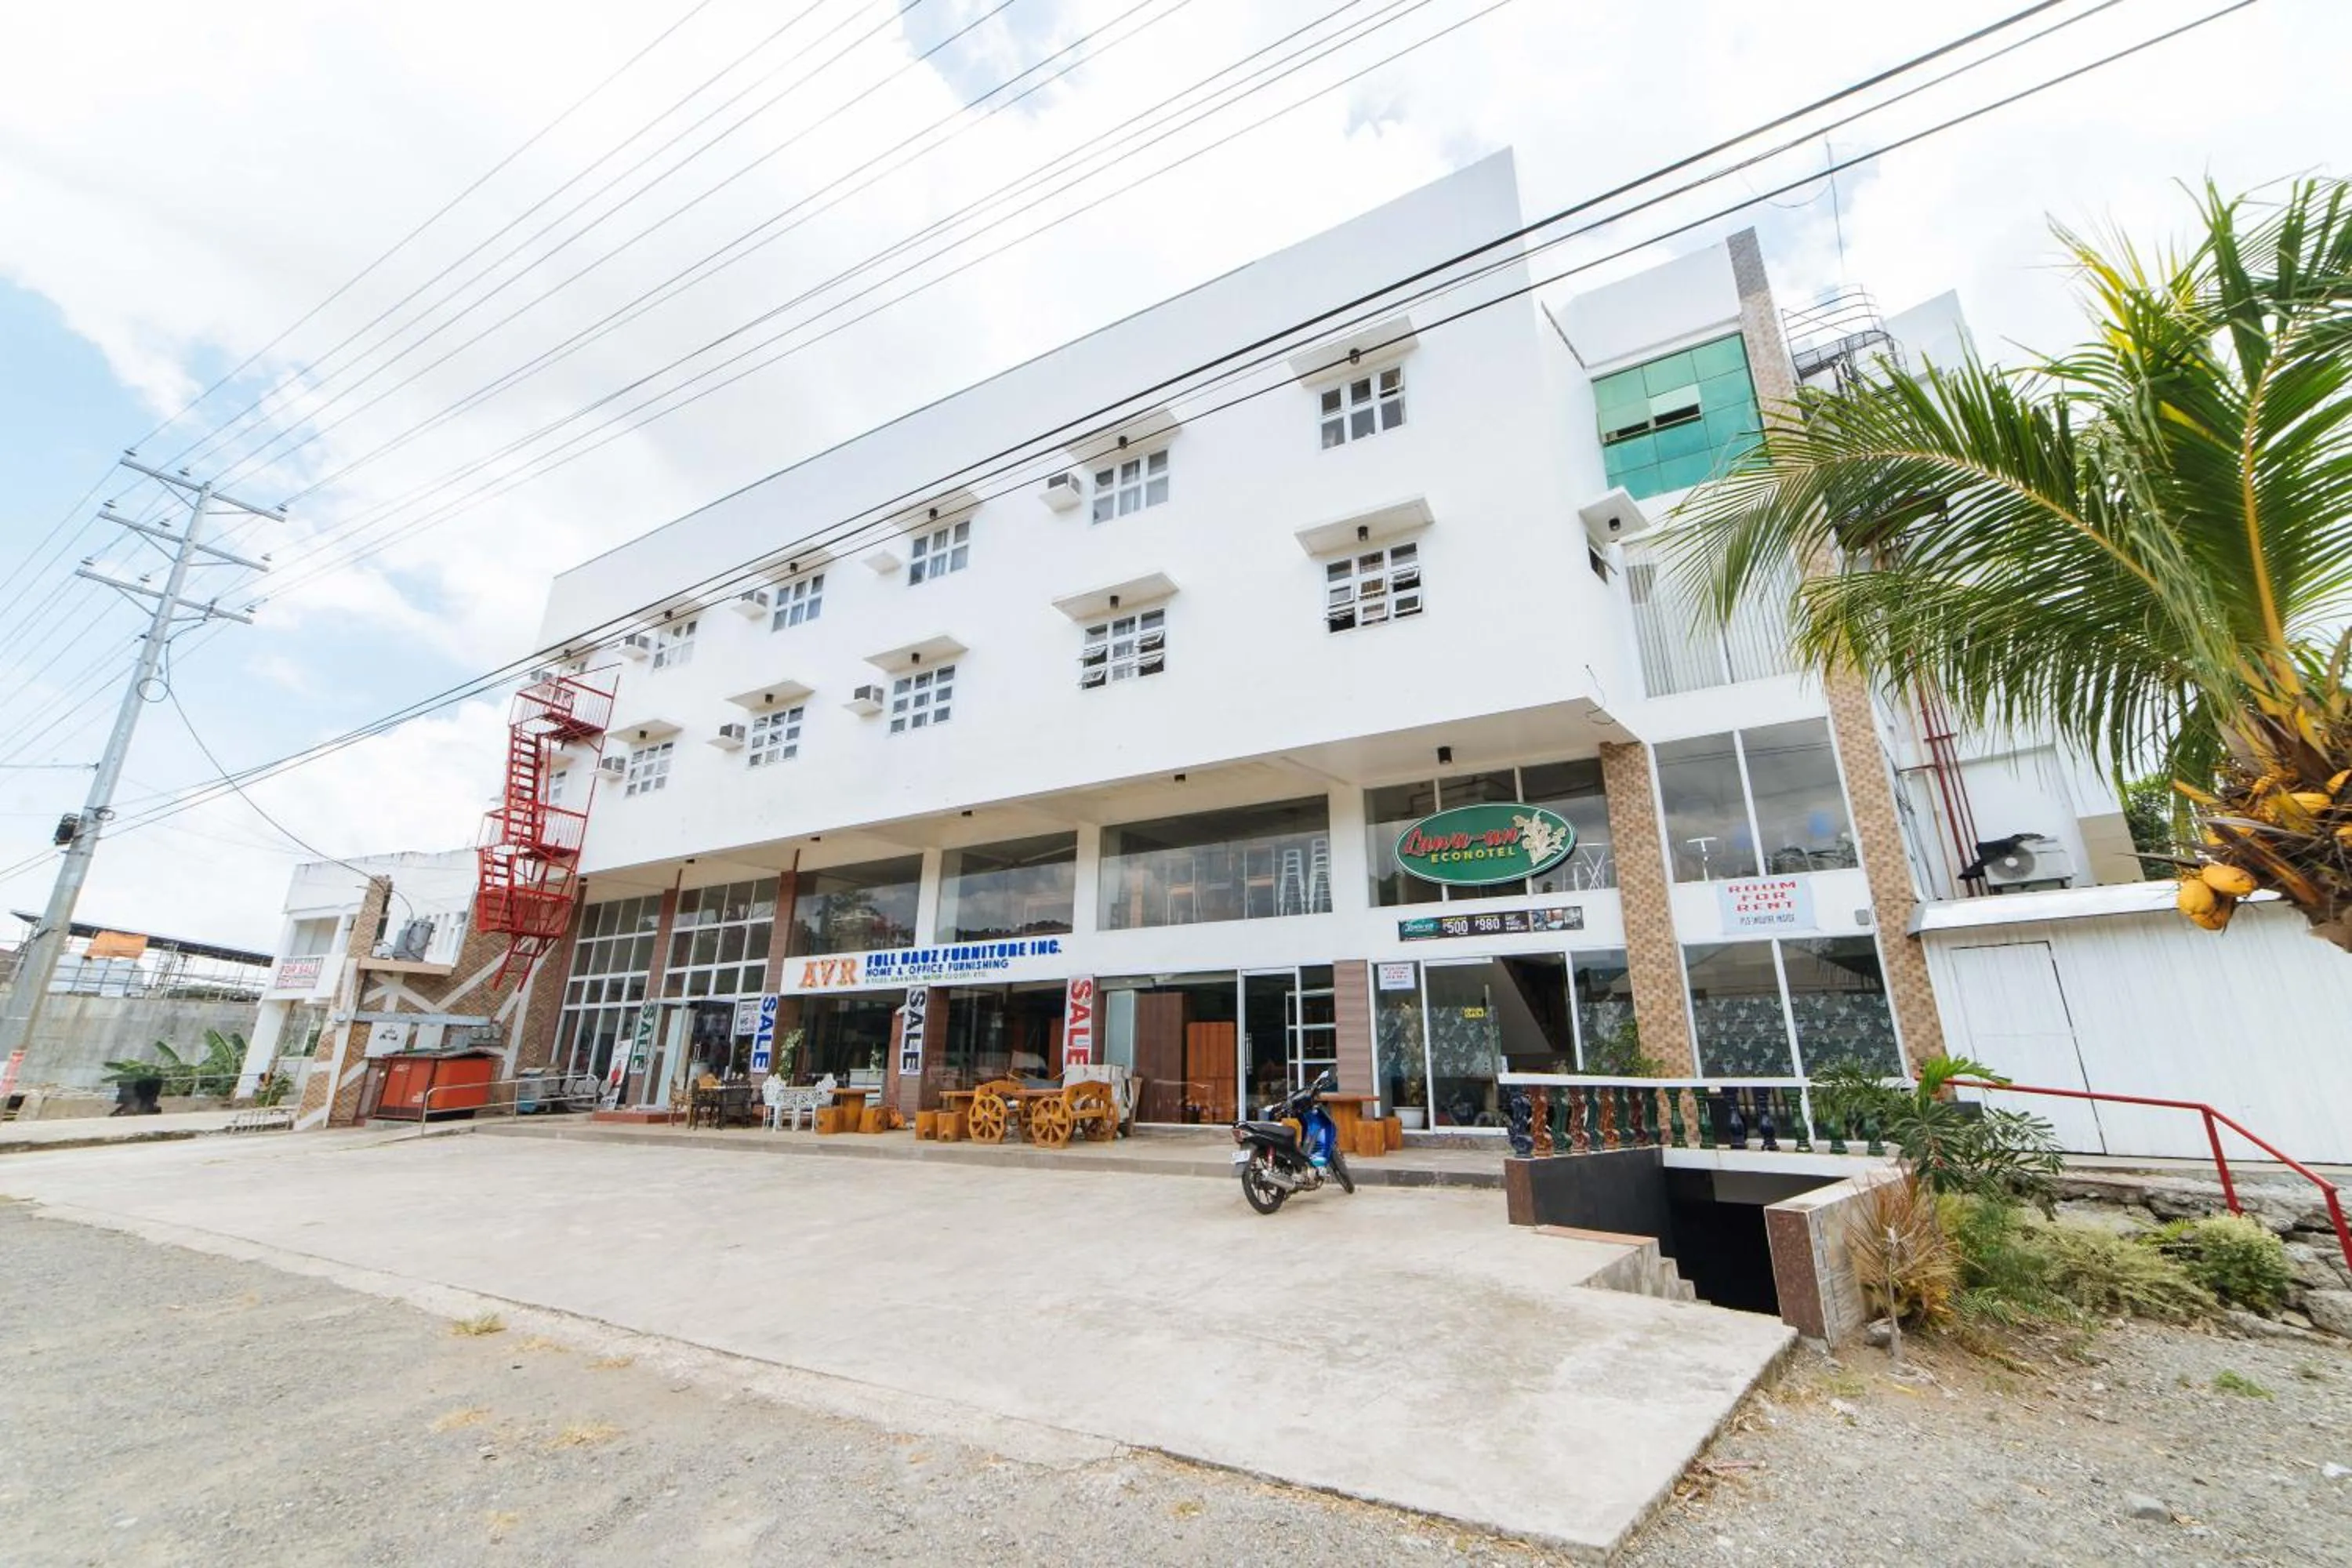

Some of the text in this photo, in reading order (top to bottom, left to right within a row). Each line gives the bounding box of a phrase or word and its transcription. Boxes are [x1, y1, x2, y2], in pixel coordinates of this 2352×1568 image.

[1431, 846, 1516, 863] ECONOTEL
[1729, 881, 1796, 892] ROOM
[1742, 891, 1787, 902] FOR
[1737, 902, 1792, 911] RENT
[865, 967, 891, 978] HOME
[909, 964, 943, 975] OFFICE
[948, 958, 1009, 972] FURNISHING
[866, 953, 896, 968] FULL
[942, 942, 1026, 963] FURNITURE
[1031, 939, 1062, 956] INC.
[799, 958, 858, 988] AVR
[751, 996, 778, 1069] SALE
[902, 989, 927, 1070] SALE
[1066, 978, 1093, 1066] SALE
[632, 1003, 655, 1071] SALE
